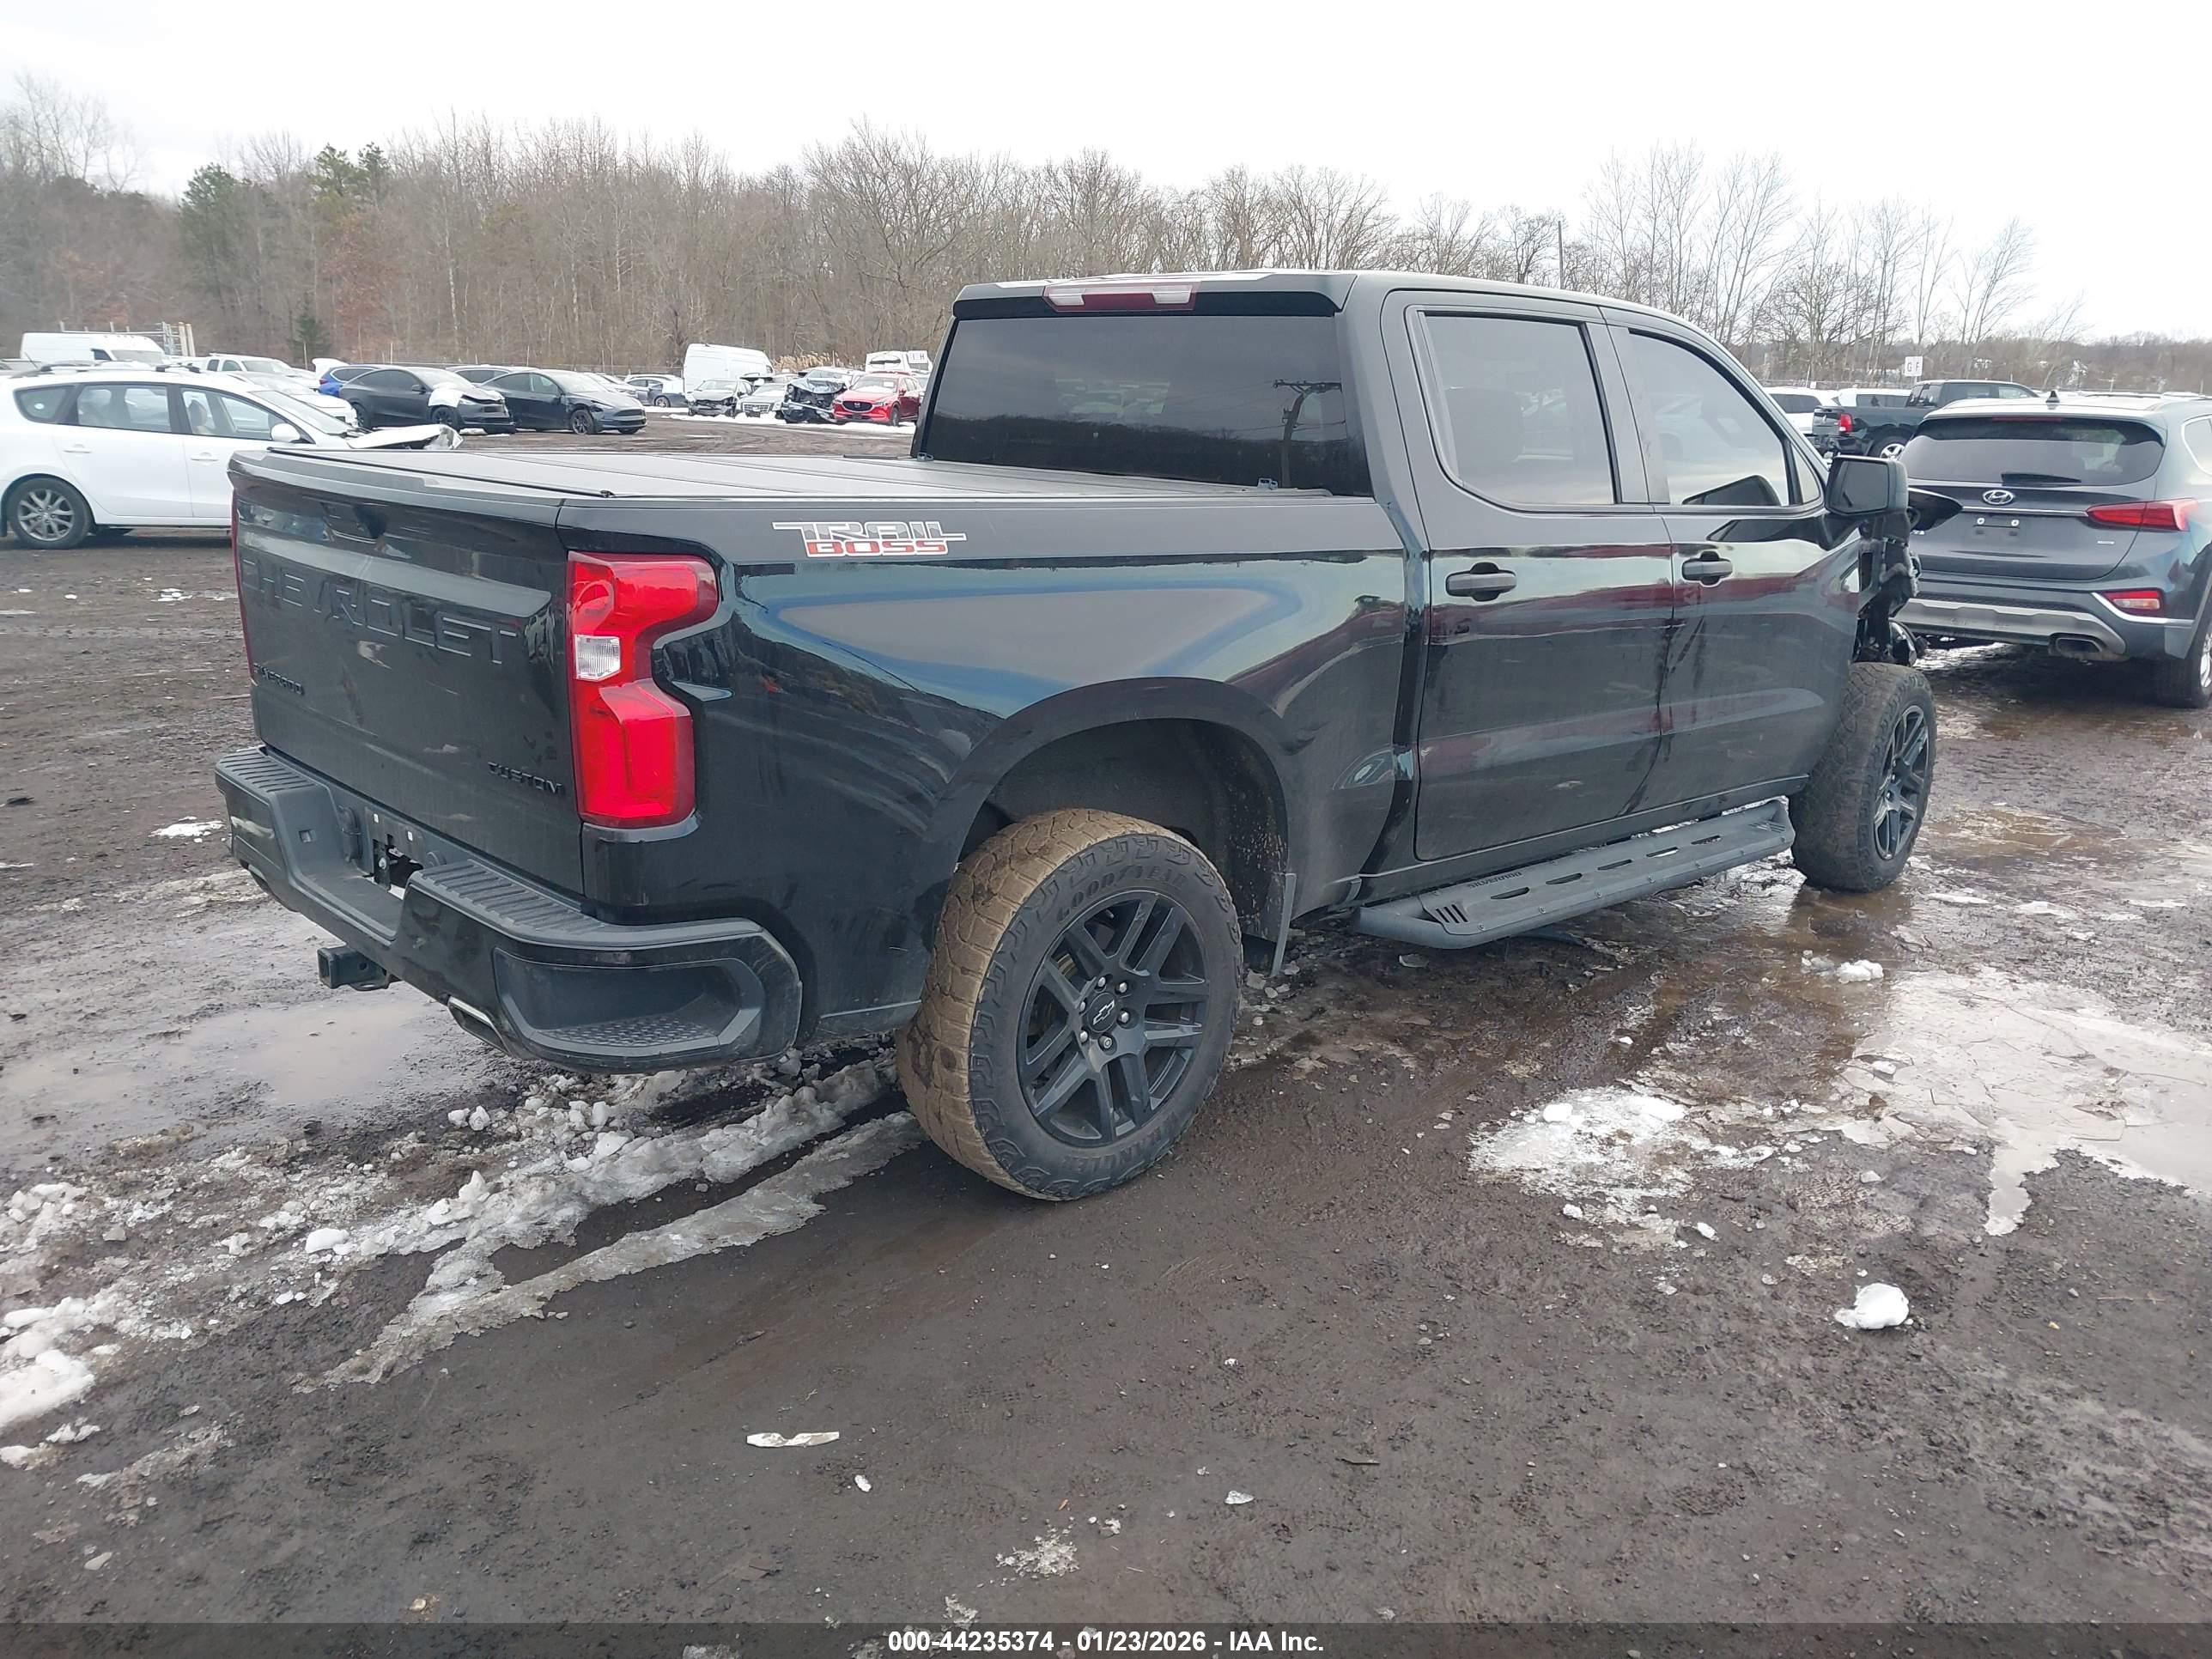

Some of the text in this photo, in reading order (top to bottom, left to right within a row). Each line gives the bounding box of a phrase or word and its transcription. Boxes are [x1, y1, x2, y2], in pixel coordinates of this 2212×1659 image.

[773, 522, 966, 541] TRAIL
[805, 540, 948, 557] BOSS
[240, 558, 520, 665] CHEVROLET
[488, 762, 563, 795] CUSTOM
